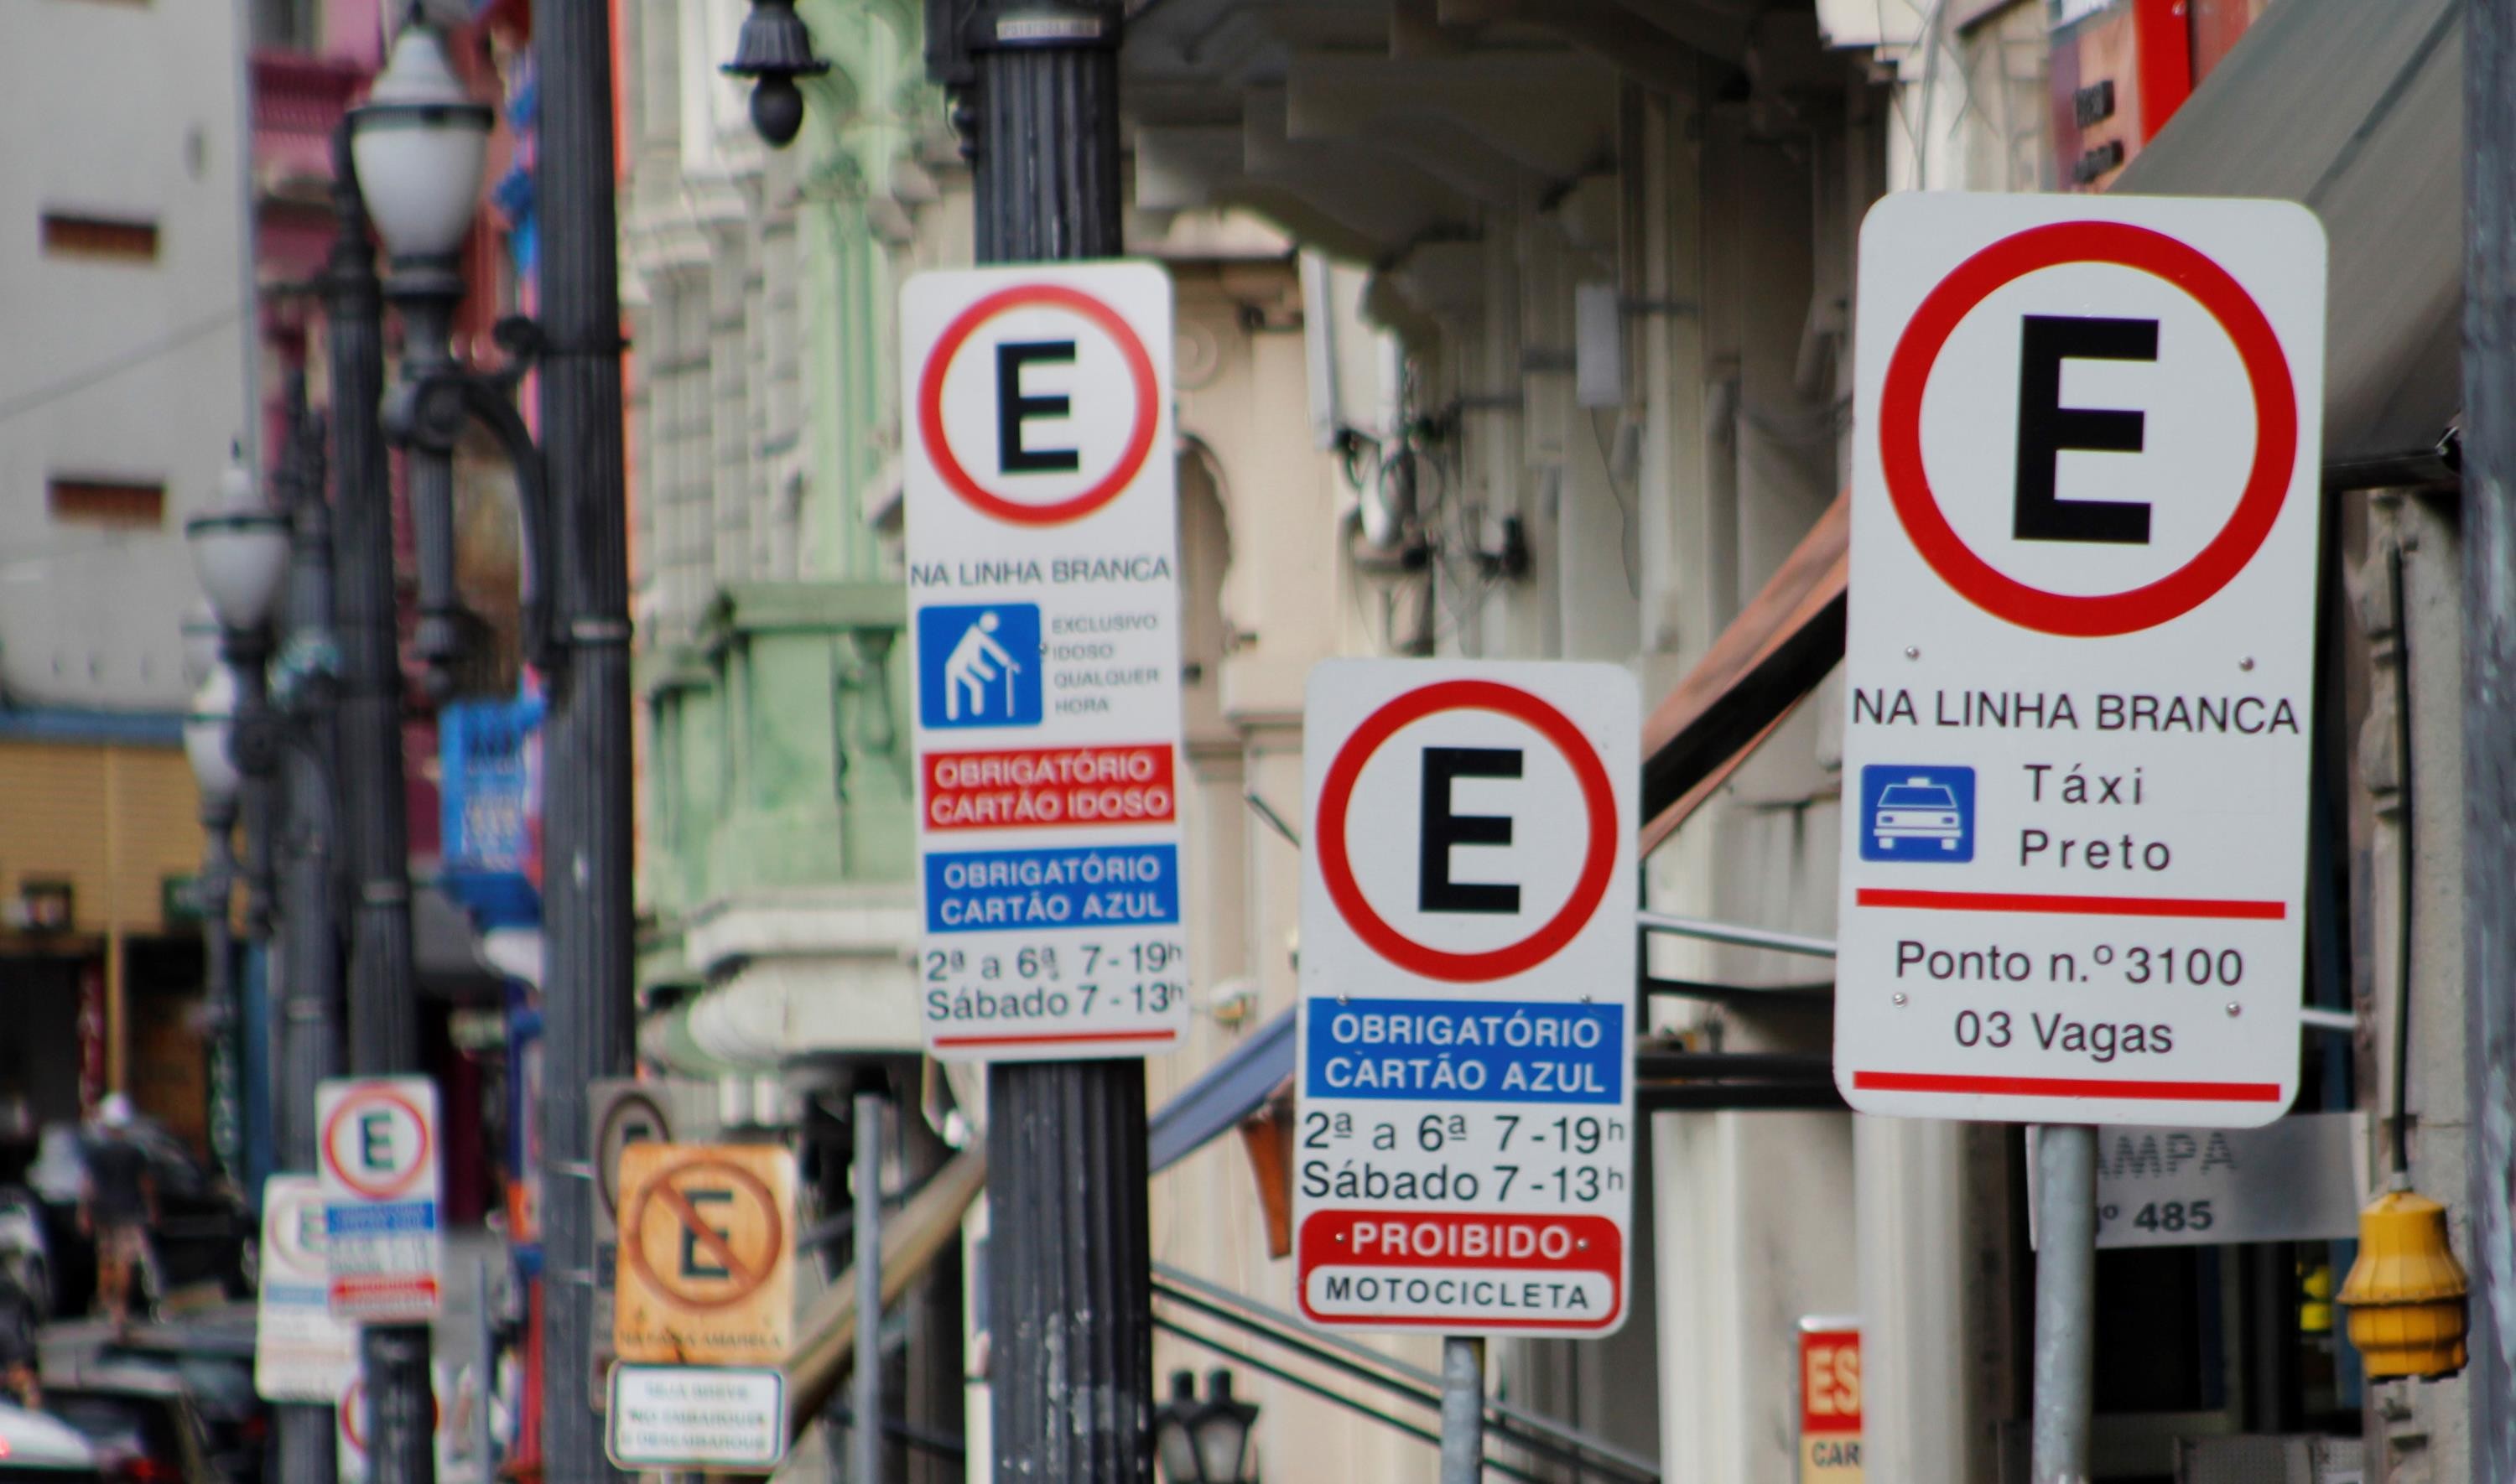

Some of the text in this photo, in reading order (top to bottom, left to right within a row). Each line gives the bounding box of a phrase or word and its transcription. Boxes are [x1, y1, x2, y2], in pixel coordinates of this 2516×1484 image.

[995, 340, 1079, 475] E
[2013, 314, 2160, 544] E
[911, 556, 1171, 587] NA LINHA BRANCA
[1052, 615, 1158, 636] EXCLUSIVO
[1052, 644, 1115, 661] IDOSO
[1054, 668, 1160, 688] QUALQUER
[1055, 698, 1109, 714] HORA
[1852, 688, 2300, 734] NA LINHA BRANCA
[933, 747, 1155, 790] OBRIGATÓRIO
[2024, 762, 2145, 806] Táxi
[930, 786, 1172, 825] CARTÃO IDOSO
[1419, 746, 1524, 913] E
[2020, 829, 2172, 872] Preto
[943, 853, 1162, 890] OBRIGATÓRIO
[940, 890, 1167, 926] CARTÃO AZUL
[981, 956, 1001, 980] a
[1896, 941, 2031, 982] Ponto
[2124, 947, 2244, 986] 3100
[926, 988, 1069, 1021] Sábado
[1331, 1009, 1602, 1048] OBRIGATÓRIO
[1954, 1010, 2174, 1063] 03 Vagas
[1324, 1053, 1606, 1093] CARTÃO AZUL
[358, 1110, 395, 1169] E
[1372, 1122, 1396, 1150] a
[2097, 1131, 2238, 1180] MPA
[1302, 1160, 1479, 1201] Sábado
[681, 1189, 734, 1279] E
[2133, 1200, 2214, 1232] 485
[1352, 1221, 1572, 1259] PROIBIDO
[1325, 1276, 1589, 1310] MOTOCICLETA
[1806, 1348, 1860, 1415] ES
[1812, 1440, 1861, 1467] CAR
